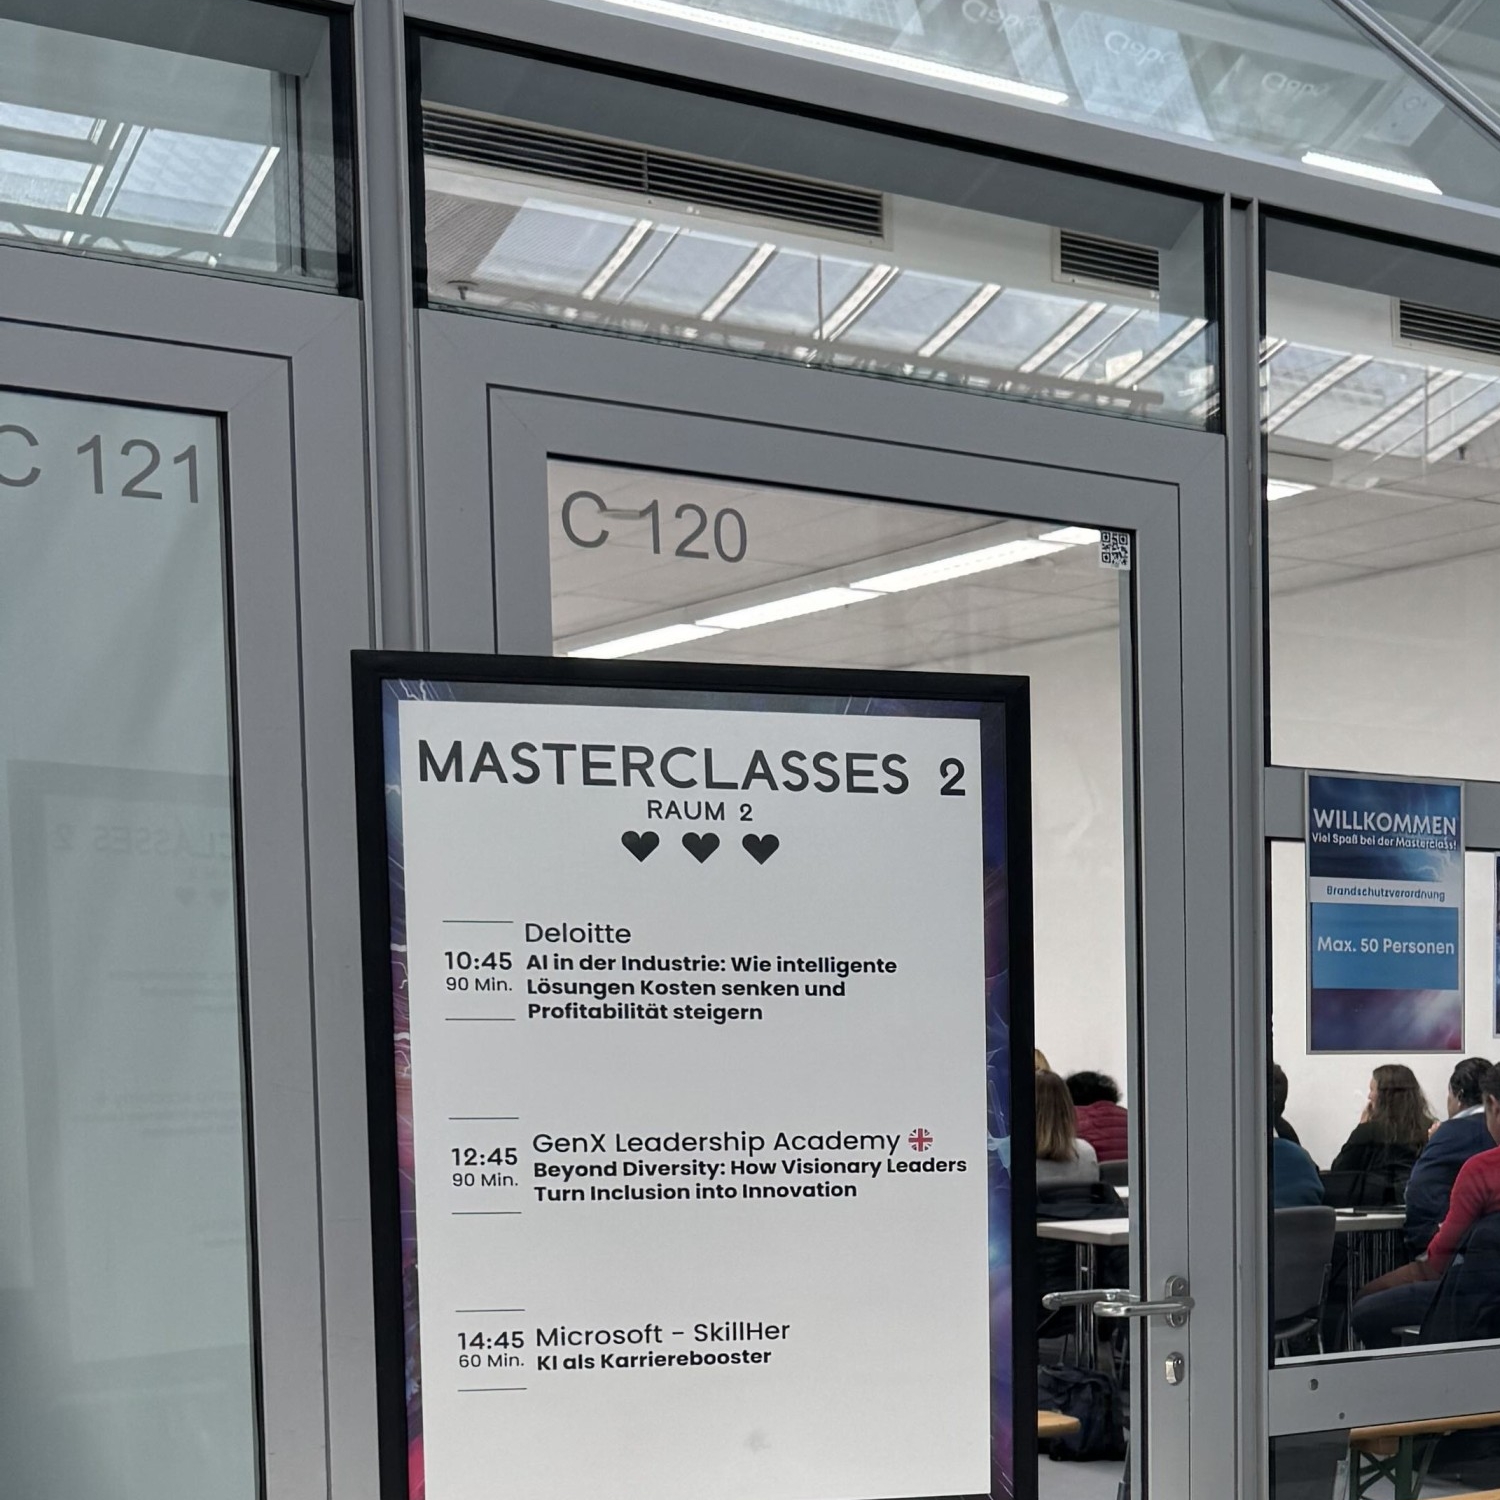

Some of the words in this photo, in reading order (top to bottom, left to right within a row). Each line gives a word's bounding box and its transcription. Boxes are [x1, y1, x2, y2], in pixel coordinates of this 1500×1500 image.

[0, 425, 42, 488] C
[76, 435, 200, 504] 121
[561, 490, 610, 550] C
[641, 499, 748, 563] 120
[418, 739, 909, 796] MASTERCLASSES
[939, 757, 967, 796] 2
[647, 799, 726, 822] RAUM
[740, 803, 754, 822] 2
[1313, 808, 1456, 836] WILLKOMMEN
[1312, 832, 1331, 843] Viel
[1332, 834, 1358, 846] Spaß
[1360, 835, 1376, 845] bei
[1377, 835, 1394, 846] der
[1395, 837, 1457, 850] Masterclass!
[1327, 885, 1446, 903] Brandschutzverordnung
[525, 922, 632, 944] Deloitte
[1317, 936, 1357, 952] Max.
[1360, 938, 1379, 953] 50
[1383, 938, 1455, 955] Personen
[445, 951, 513, 971] 10:45
[526, 954, 548, 971] AI
[553, 953, 574, 970] in
[579, 954, 616, 971] der
[622, 955, 726, 973] Industrie:
[731, 955, 772, 973] Wie
[776, 955, 898, 978] intelligente
[446, 977, 469, 991] 90
[475, 976, 513, 992] Min.
[527, 978, 635, 1000] Lösungen
[641, 979, 716, 996] Kosten
[721, 980, 800, 997] senken
[805, 981, 846, 997] und
[528, 1002, 669, 1020] Profitabilität
[673, 1002, 763, 1025] steigern
[532, 1133, 606, 1153] GenX
[616, 1131, 765, 1157] Leadership
[773, 1130, 901, 1156] Academy
[451, 1147, 518, 1166] 12:45
[452, 1172, 475, 1187] 90
[481, 1172, 519, 1187] Min.
[534, 1161, 617, 1182] Beyond
[623, 1159, 726, 1181] Diversity:
[731, 1160, 777, 1175] How
[781, 1158, 882, 1178] Visionary
[887, 1157, 967, 1173] Leaders
[534, 1186, 585, 1202] Turn
[590, 1183, 690, 1201] Inclusion
[696, 1182, 738, 1199] into
[742, 1181, 857, 1199] Innovation
[457, 1331, 525, 1350] 14:45
[536, 1323, 663, 1347] Microsoft
[693, 1321, 791, 1343] SkillHer
[458, 1354, 481, 1368] 60
[487, 1353, 525, 1368] Min.
[537, 1355, 558, 1371] KI
[563, 1354, 596, 1370] als
[600, 1348, 772, 1369] Karrierebooster
